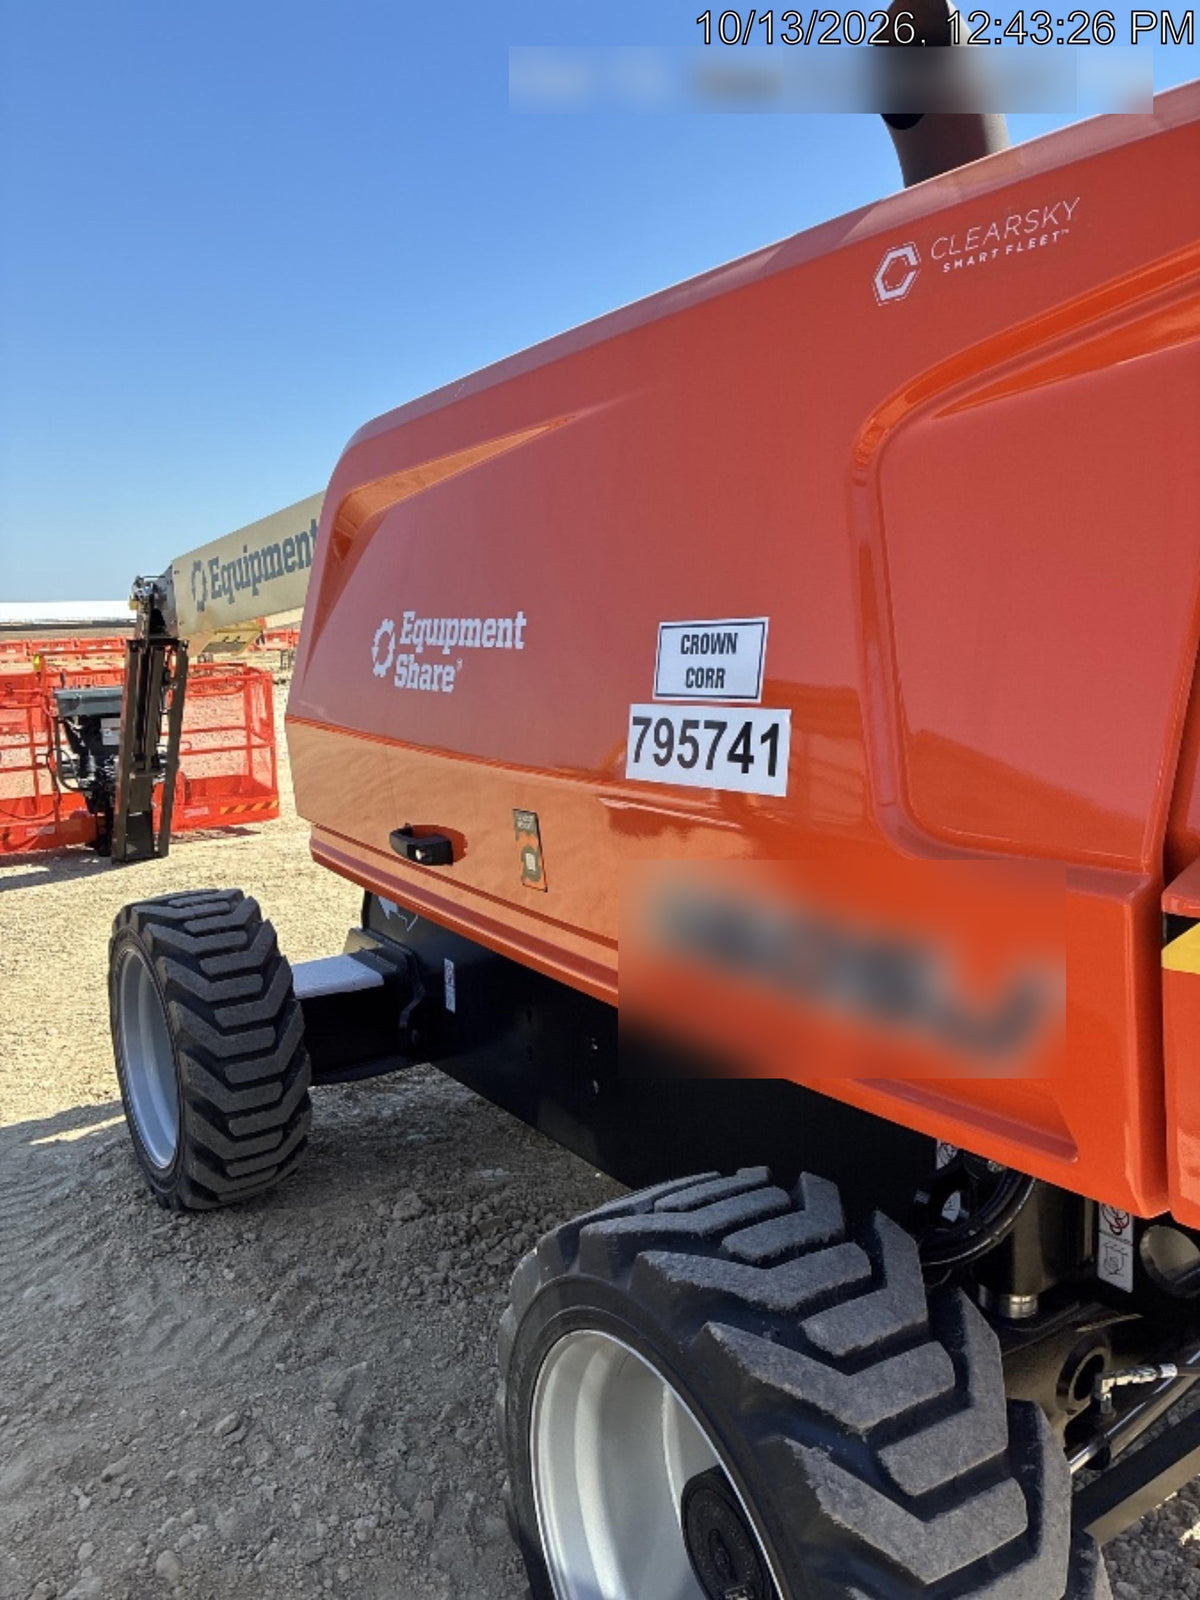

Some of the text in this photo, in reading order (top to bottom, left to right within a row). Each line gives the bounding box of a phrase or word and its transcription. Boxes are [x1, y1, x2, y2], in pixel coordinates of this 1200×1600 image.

[930, 196, 1080, 260] CLEARSKY
[943, 248, 999, 273] SMART
[399, 611, 527, 655] Equipment
[680, 632, 738, 655] CROWN
[685, 667, 726, 689] CORR
[632, 716, 780, 777] 795741
